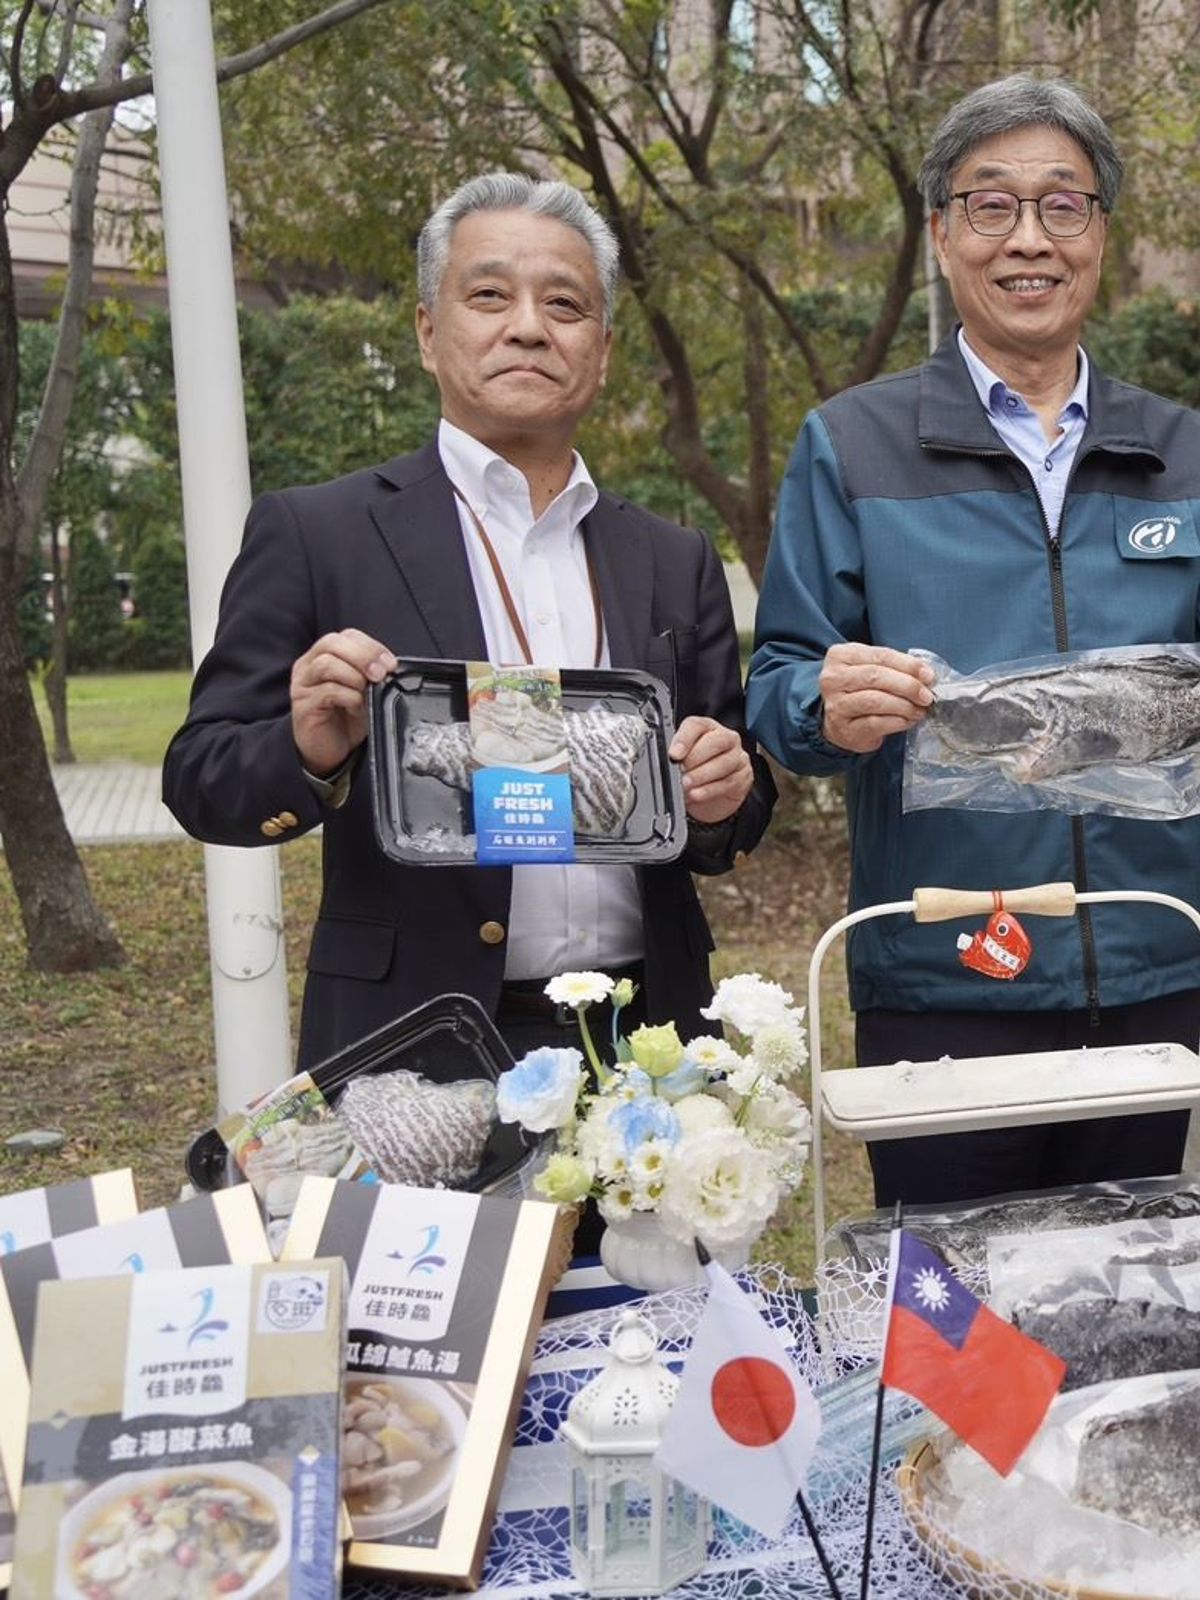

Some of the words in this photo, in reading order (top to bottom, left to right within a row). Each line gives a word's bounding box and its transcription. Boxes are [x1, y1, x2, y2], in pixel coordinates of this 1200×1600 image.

[501, 782, 545, 795] JUST
[493, 796, 554, 811] FRESH
[363, 1284, 444, 1300] JUSTFRESH
[140, 1357, 234, 1376] JUSTFRESH
[109, 1422, 254, 1461] 金湯酸菜魚
